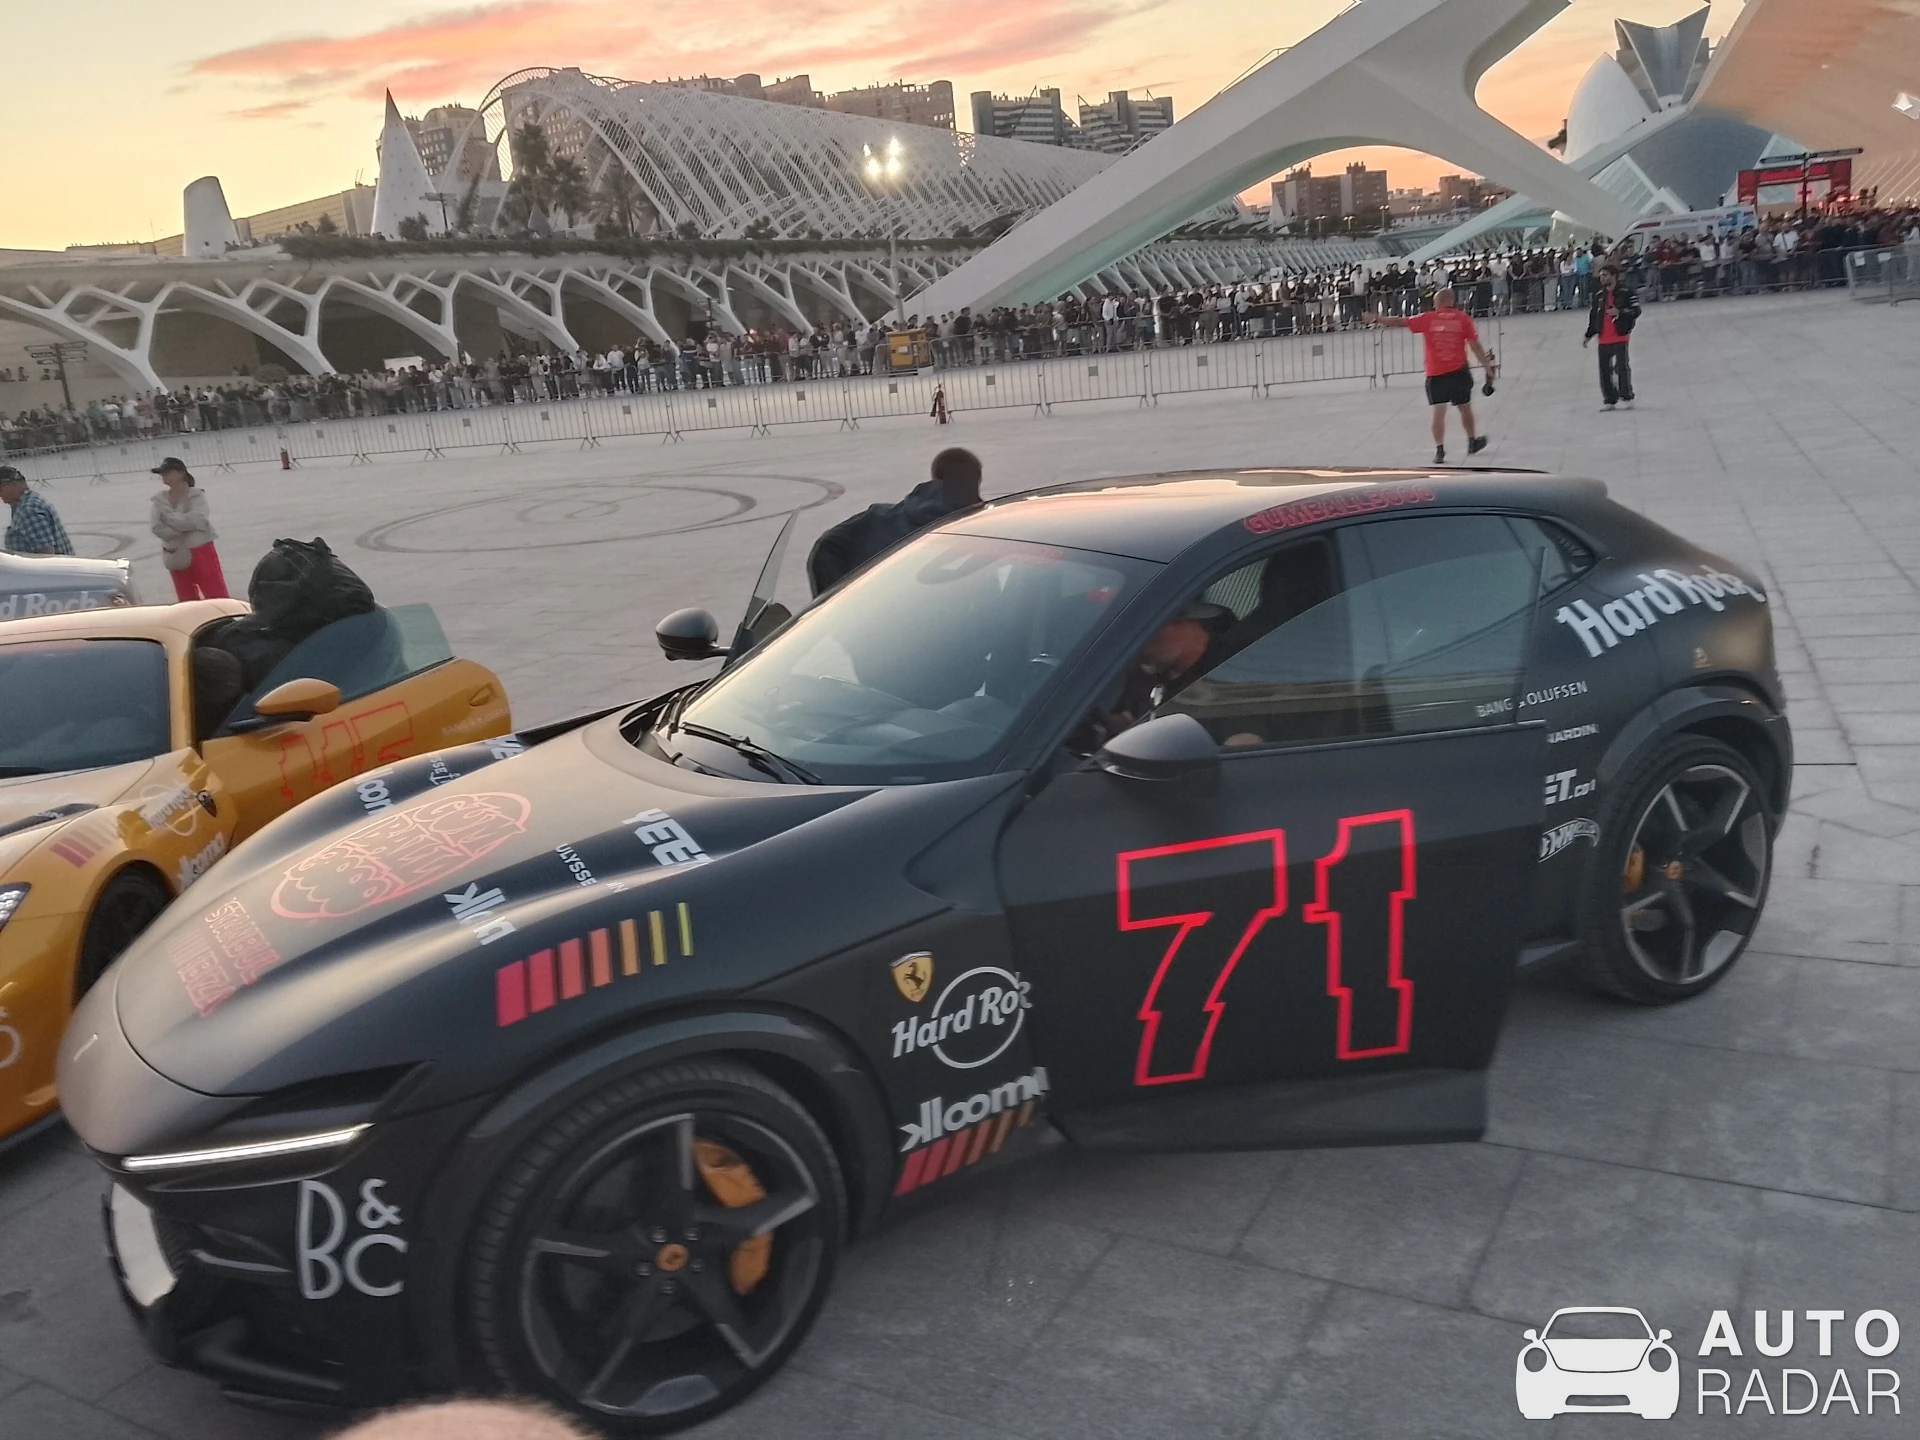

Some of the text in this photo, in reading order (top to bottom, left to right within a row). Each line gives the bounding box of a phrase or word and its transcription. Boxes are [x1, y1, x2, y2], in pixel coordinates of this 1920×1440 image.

[1555, 573, 1687, 658] Hard
[1476, 680, 1588, 718] BANG OLUFSEN
[553, 843, 598, 887] ULYSSE
[1115, 808, 1417, 1086] 71
[892, 994, 976, 1059] Hard
